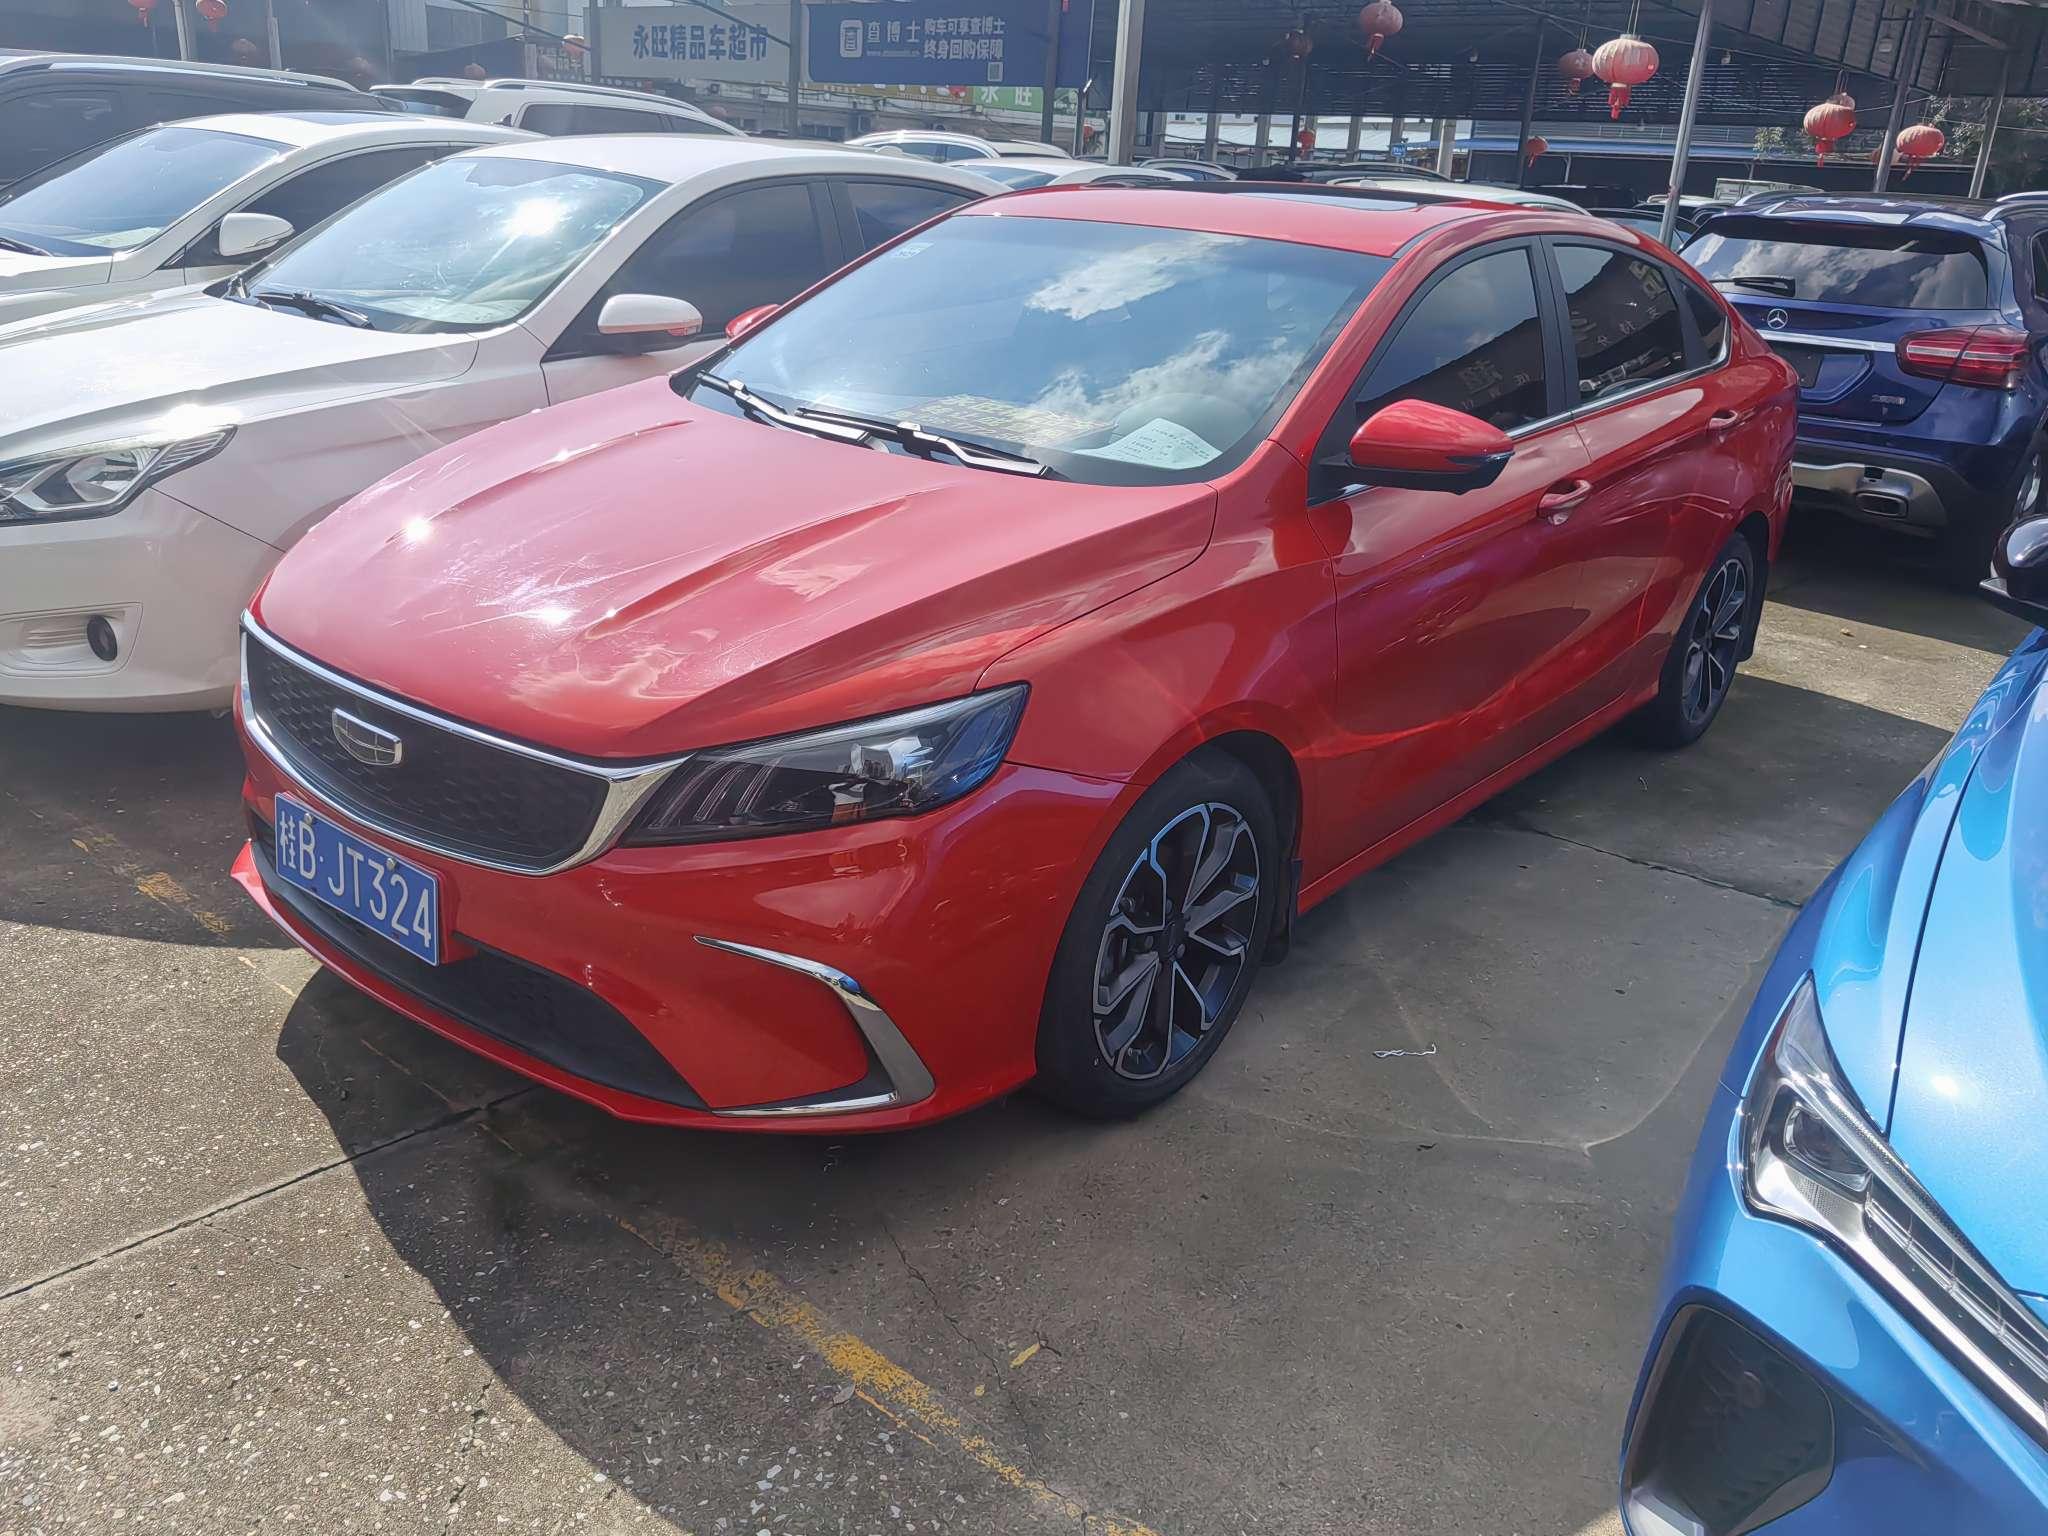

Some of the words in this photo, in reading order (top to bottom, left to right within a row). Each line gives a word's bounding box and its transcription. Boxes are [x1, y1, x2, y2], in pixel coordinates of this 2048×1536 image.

[867, 18, 921, 43] 查博士
[924, 15, 1006, 35] 购车可享查博士
[633, 24, 768, 61] 永旺精品车超市
[923, 38, 1004, 60] 终身回购保障
[280, 811, 432, 948] 桂B·JT324
